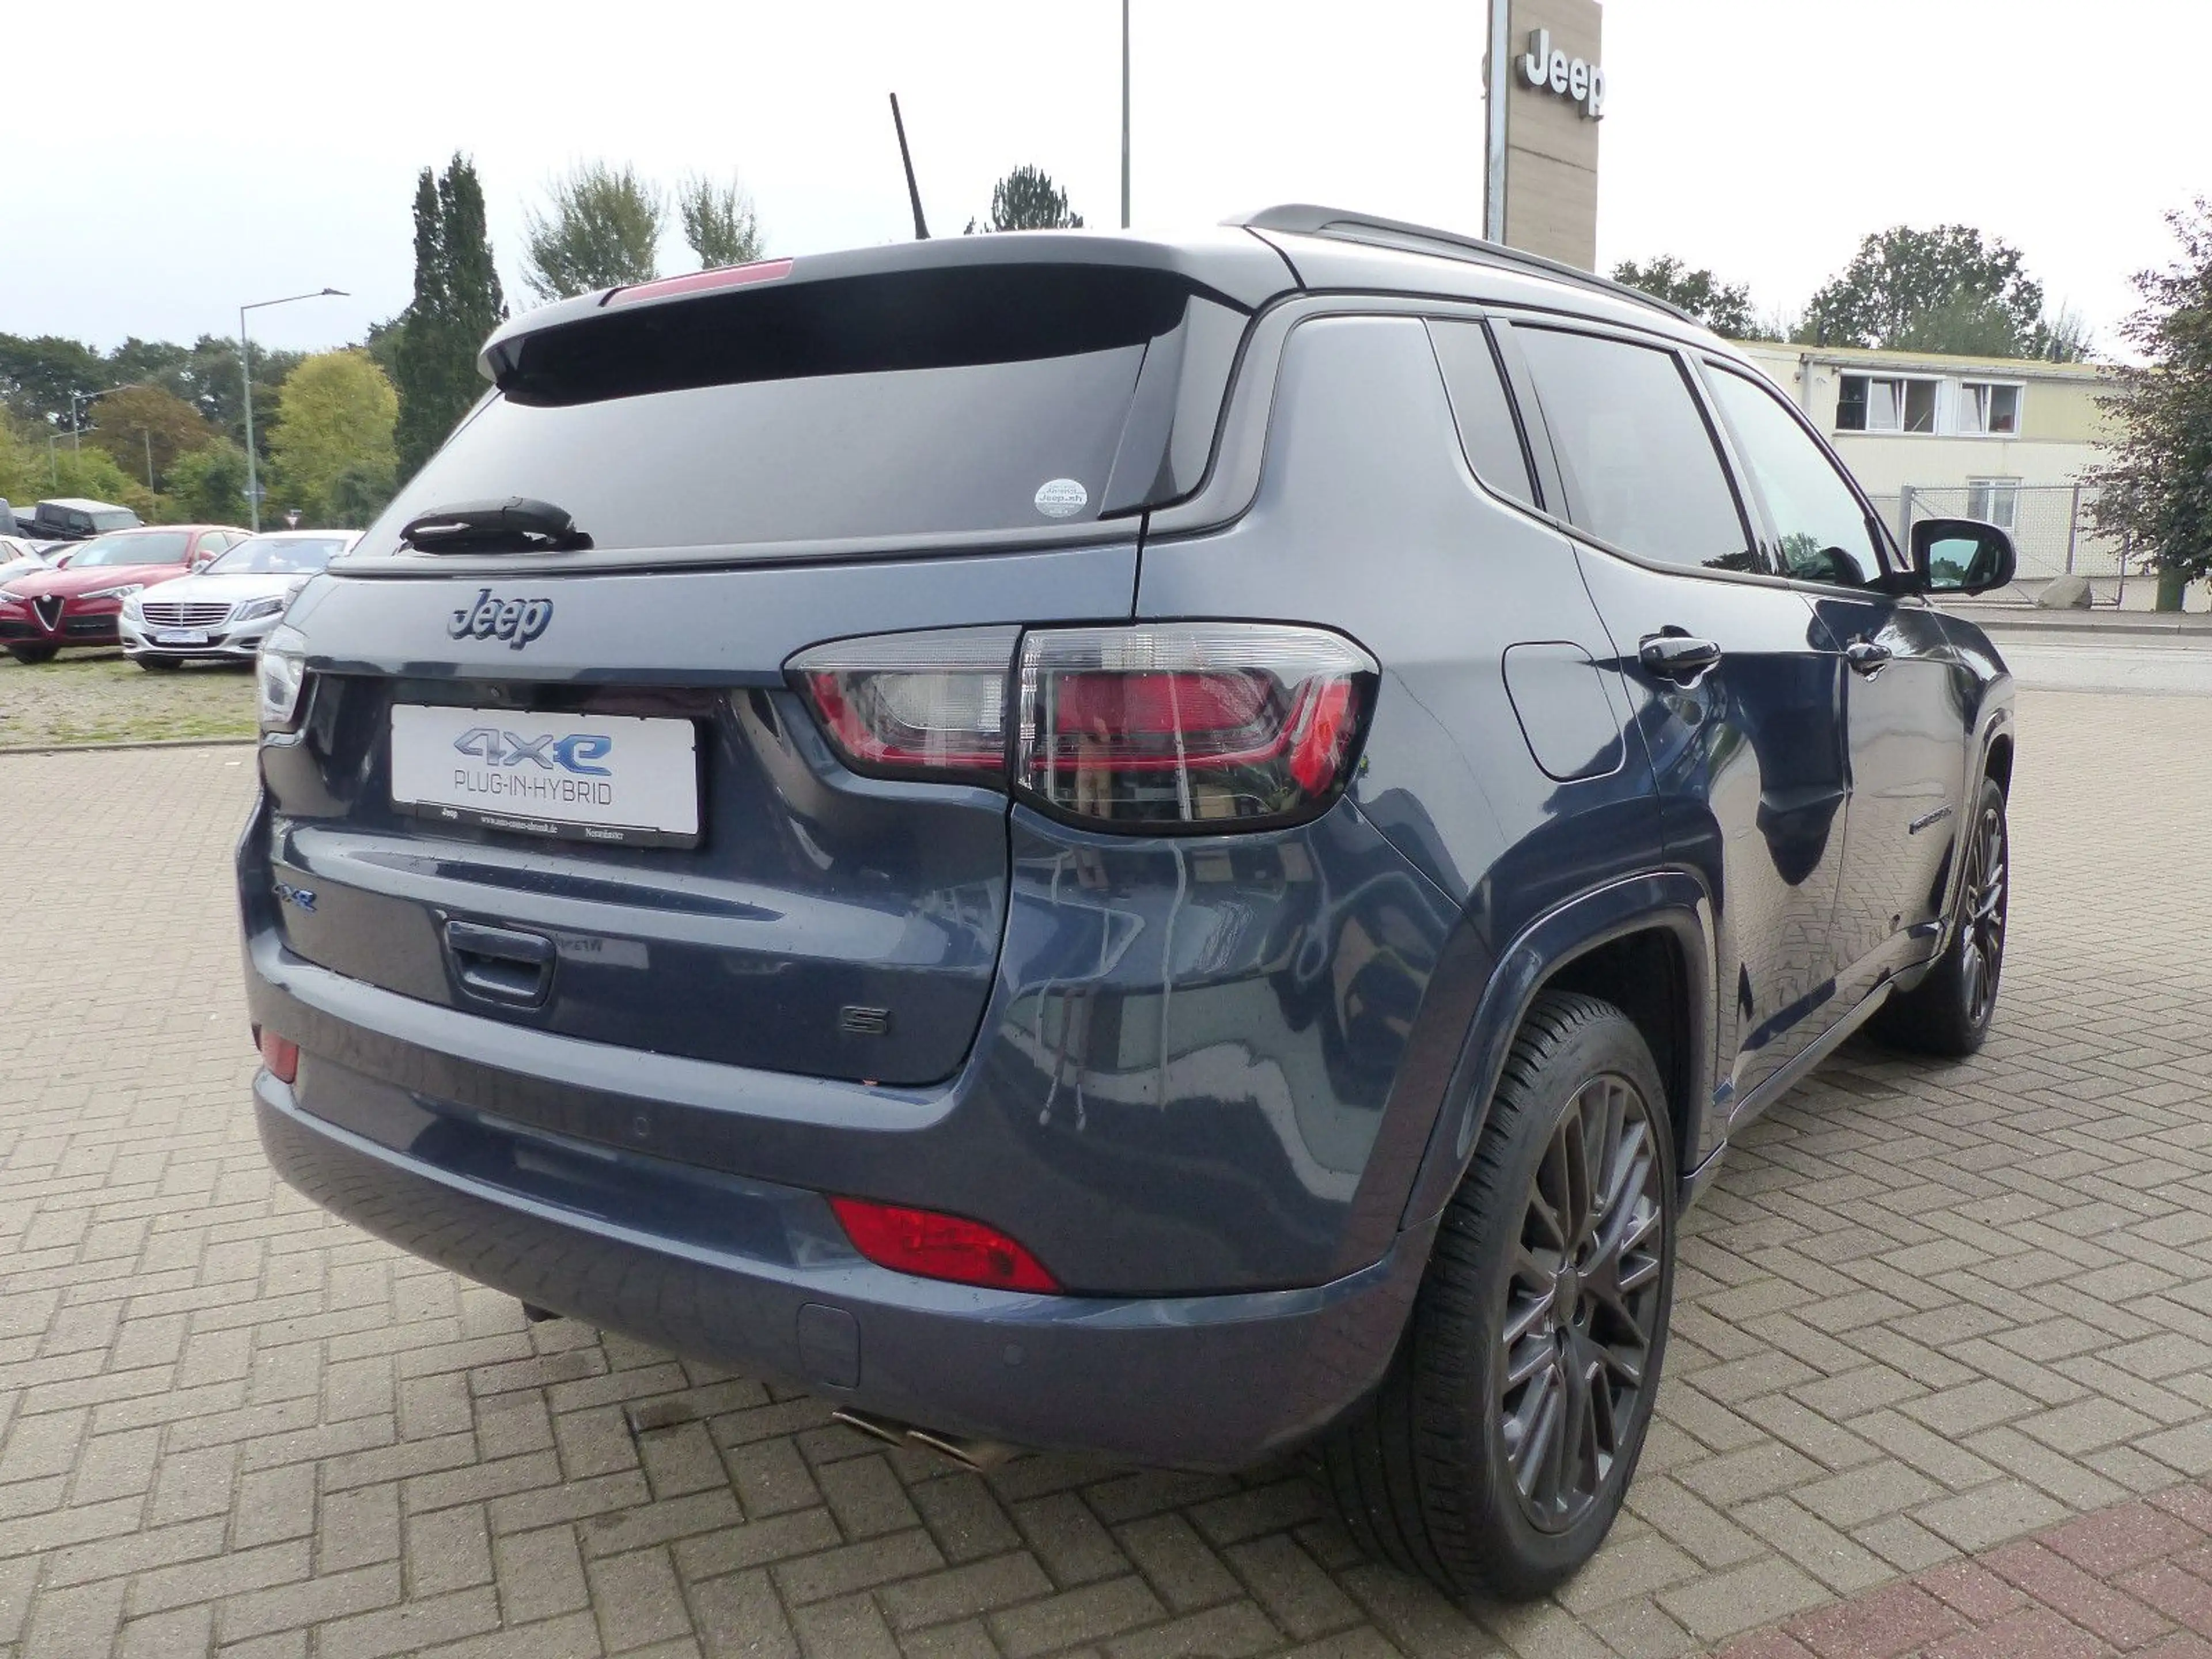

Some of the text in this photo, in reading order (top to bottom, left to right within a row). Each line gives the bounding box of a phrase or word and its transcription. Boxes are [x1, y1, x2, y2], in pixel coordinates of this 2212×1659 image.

[1517, 29, 1605, 117] Jeep
[448, 588, 554, 651] Jeep
[454, 770, 611, 805] PLUG-IN-HYBRID
